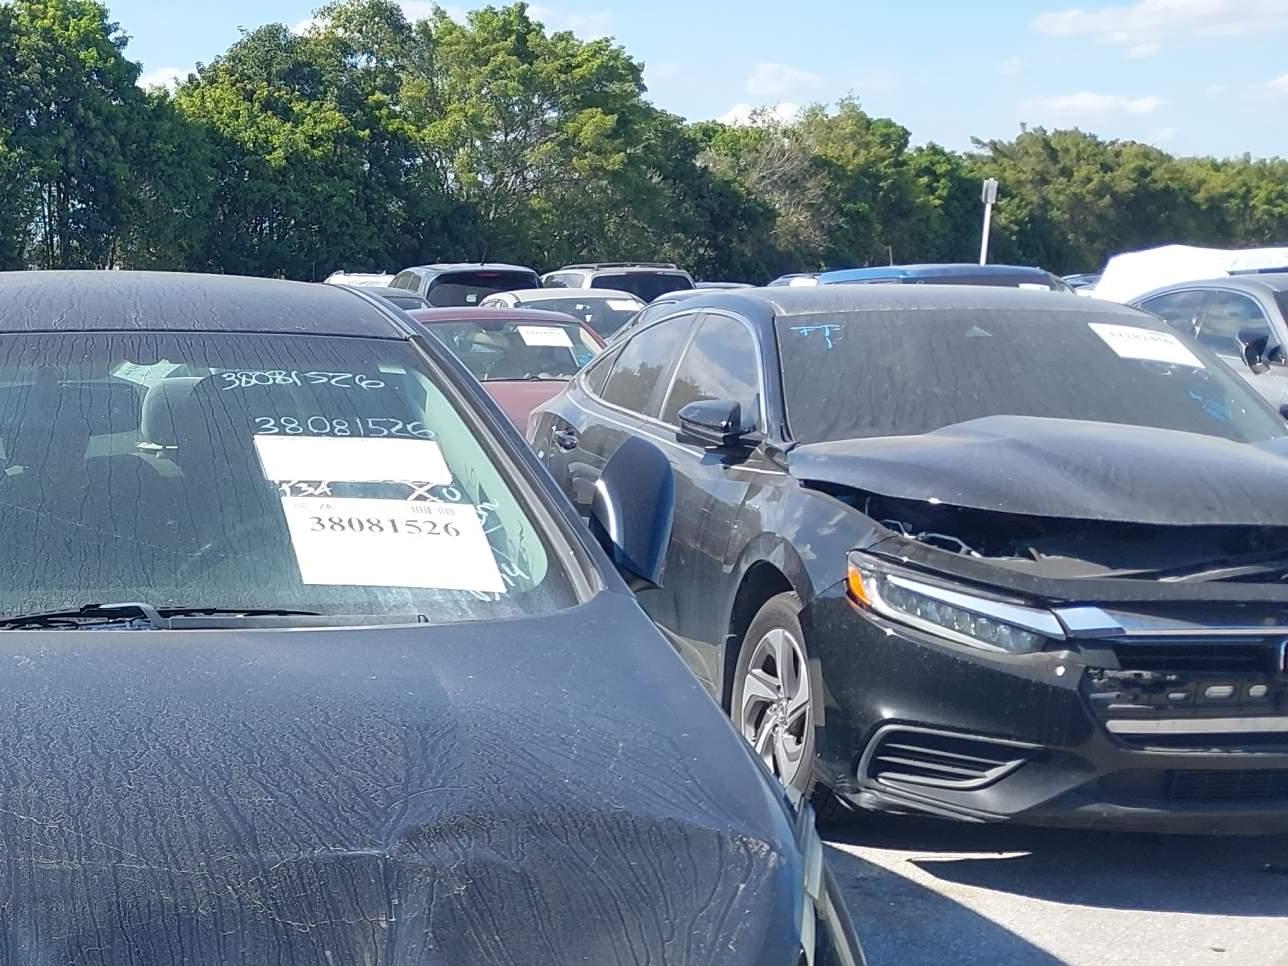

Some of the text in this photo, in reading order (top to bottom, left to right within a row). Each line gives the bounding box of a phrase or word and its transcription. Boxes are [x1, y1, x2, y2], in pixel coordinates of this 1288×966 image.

[220, 370, 386, 391] 38081526
[254, 416, 439, 437] 38081526
[309, 515, 462, 537] 38081526
